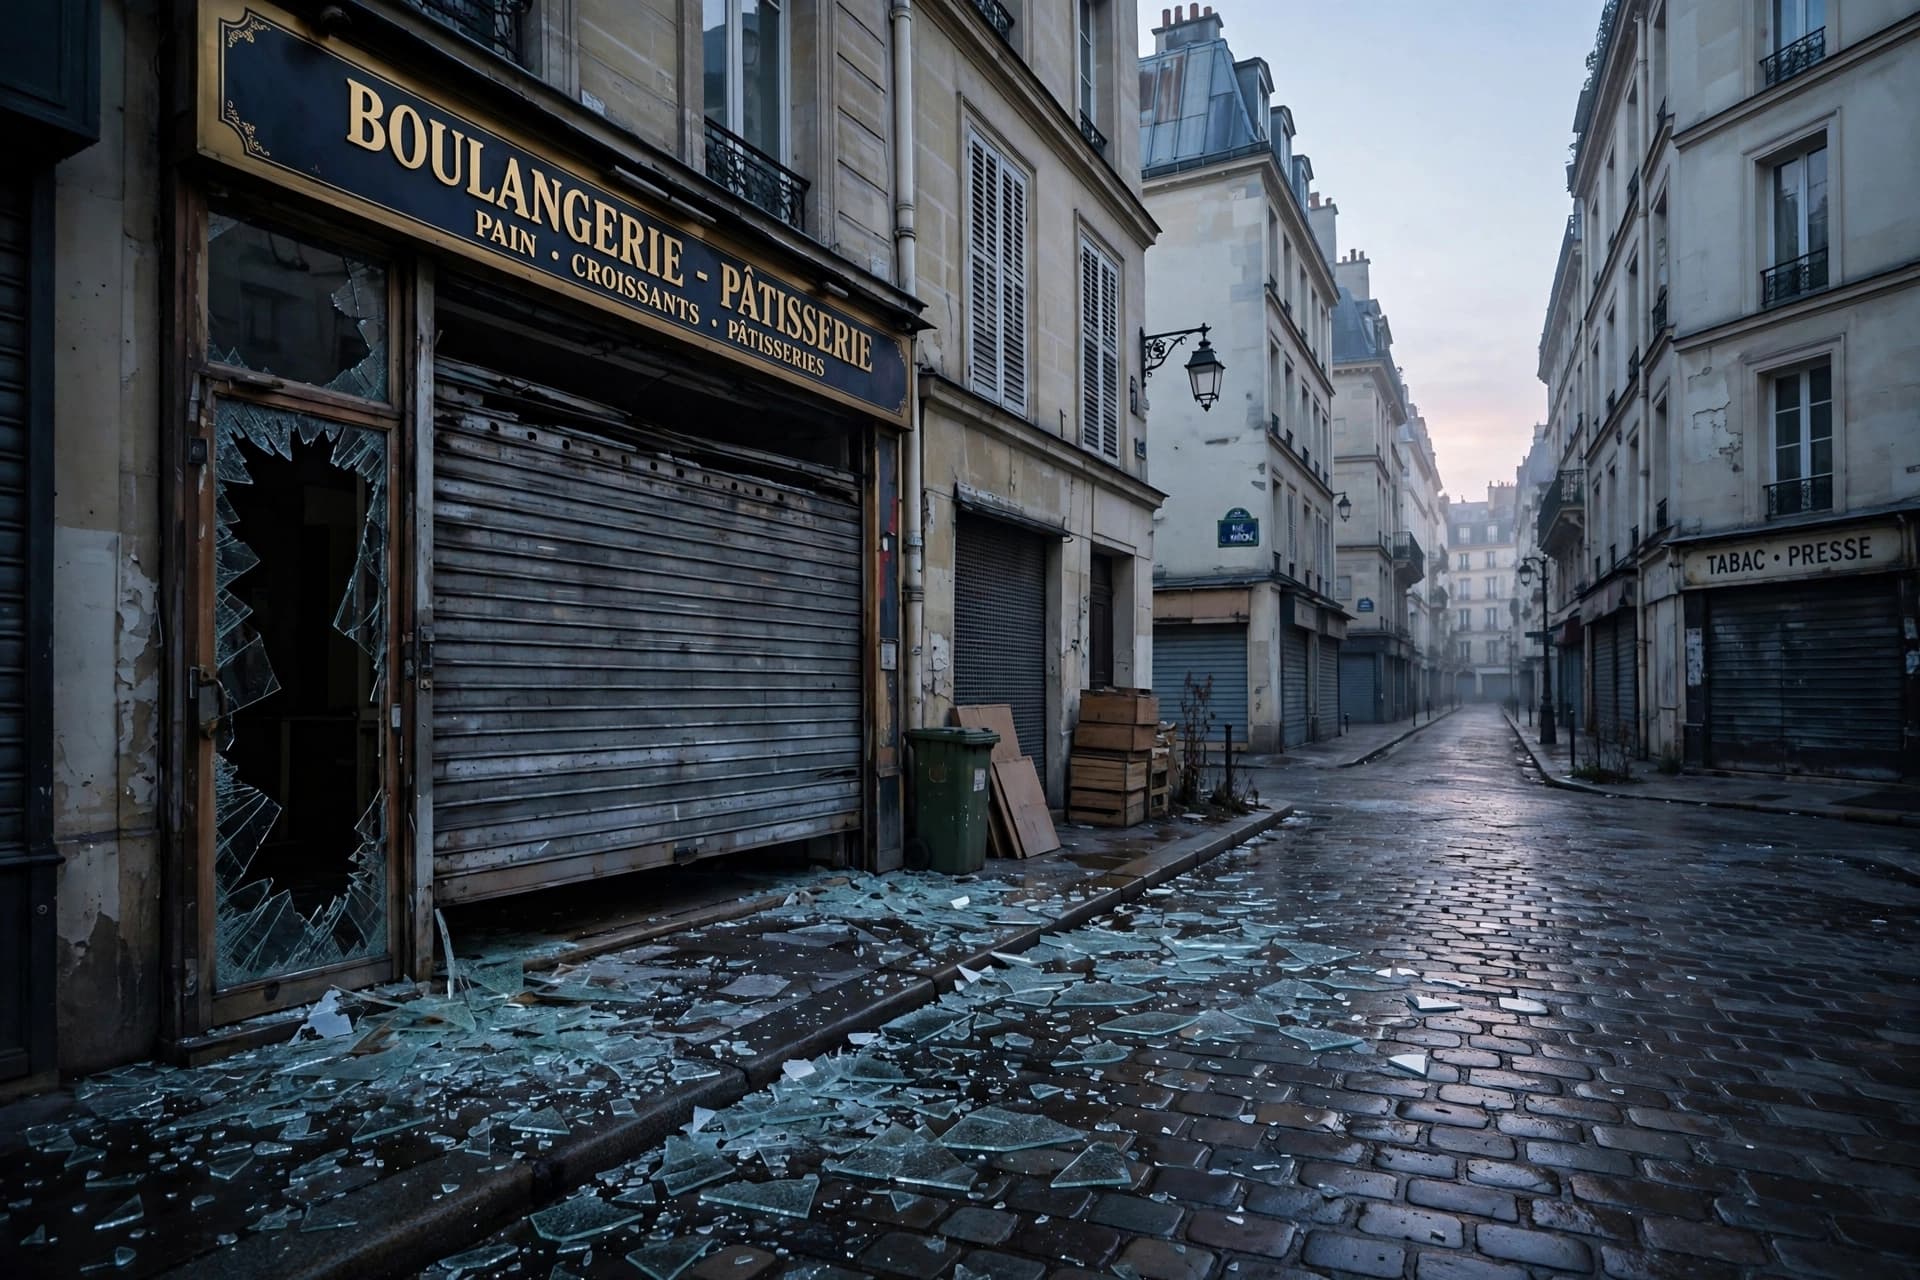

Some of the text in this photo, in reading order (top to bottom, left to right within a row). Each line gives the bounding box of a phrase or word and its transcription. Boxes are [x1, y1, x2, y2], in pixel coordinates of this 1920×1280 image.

[346, 78, 685, 288] BOULANGERIE
[720, 262, 873, 373] PÂTISSERIE
[475, 210, 825, 378] PAIN CROISSANTS PÂTISSERIES
[1706, 535, 1873, 576] TABAC PRESSE
